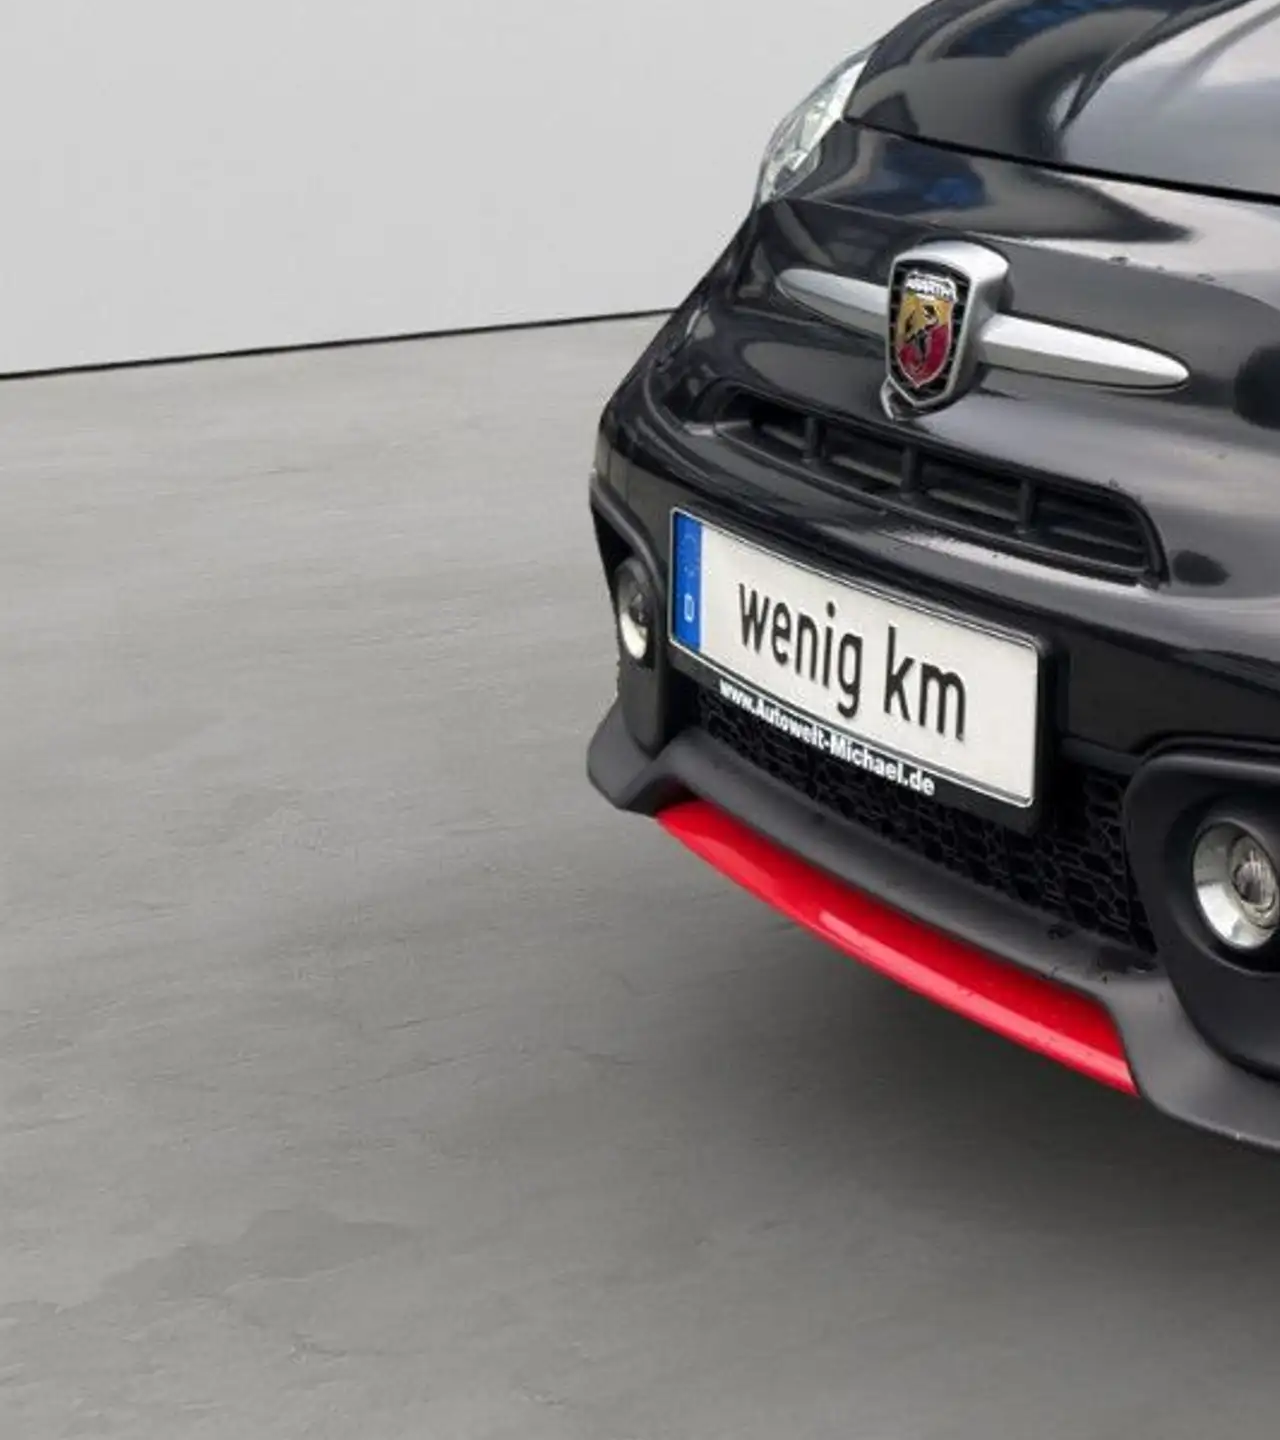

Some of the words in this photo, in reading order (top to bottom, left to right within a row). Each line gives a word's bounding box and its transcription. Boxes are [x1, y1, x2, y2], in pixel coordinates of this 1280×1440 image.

[738, 582, 864, 719] wenig
[883, 625, 967, 741] km
[718, 677, 936, 796] www.Autowelt-Michael.de
